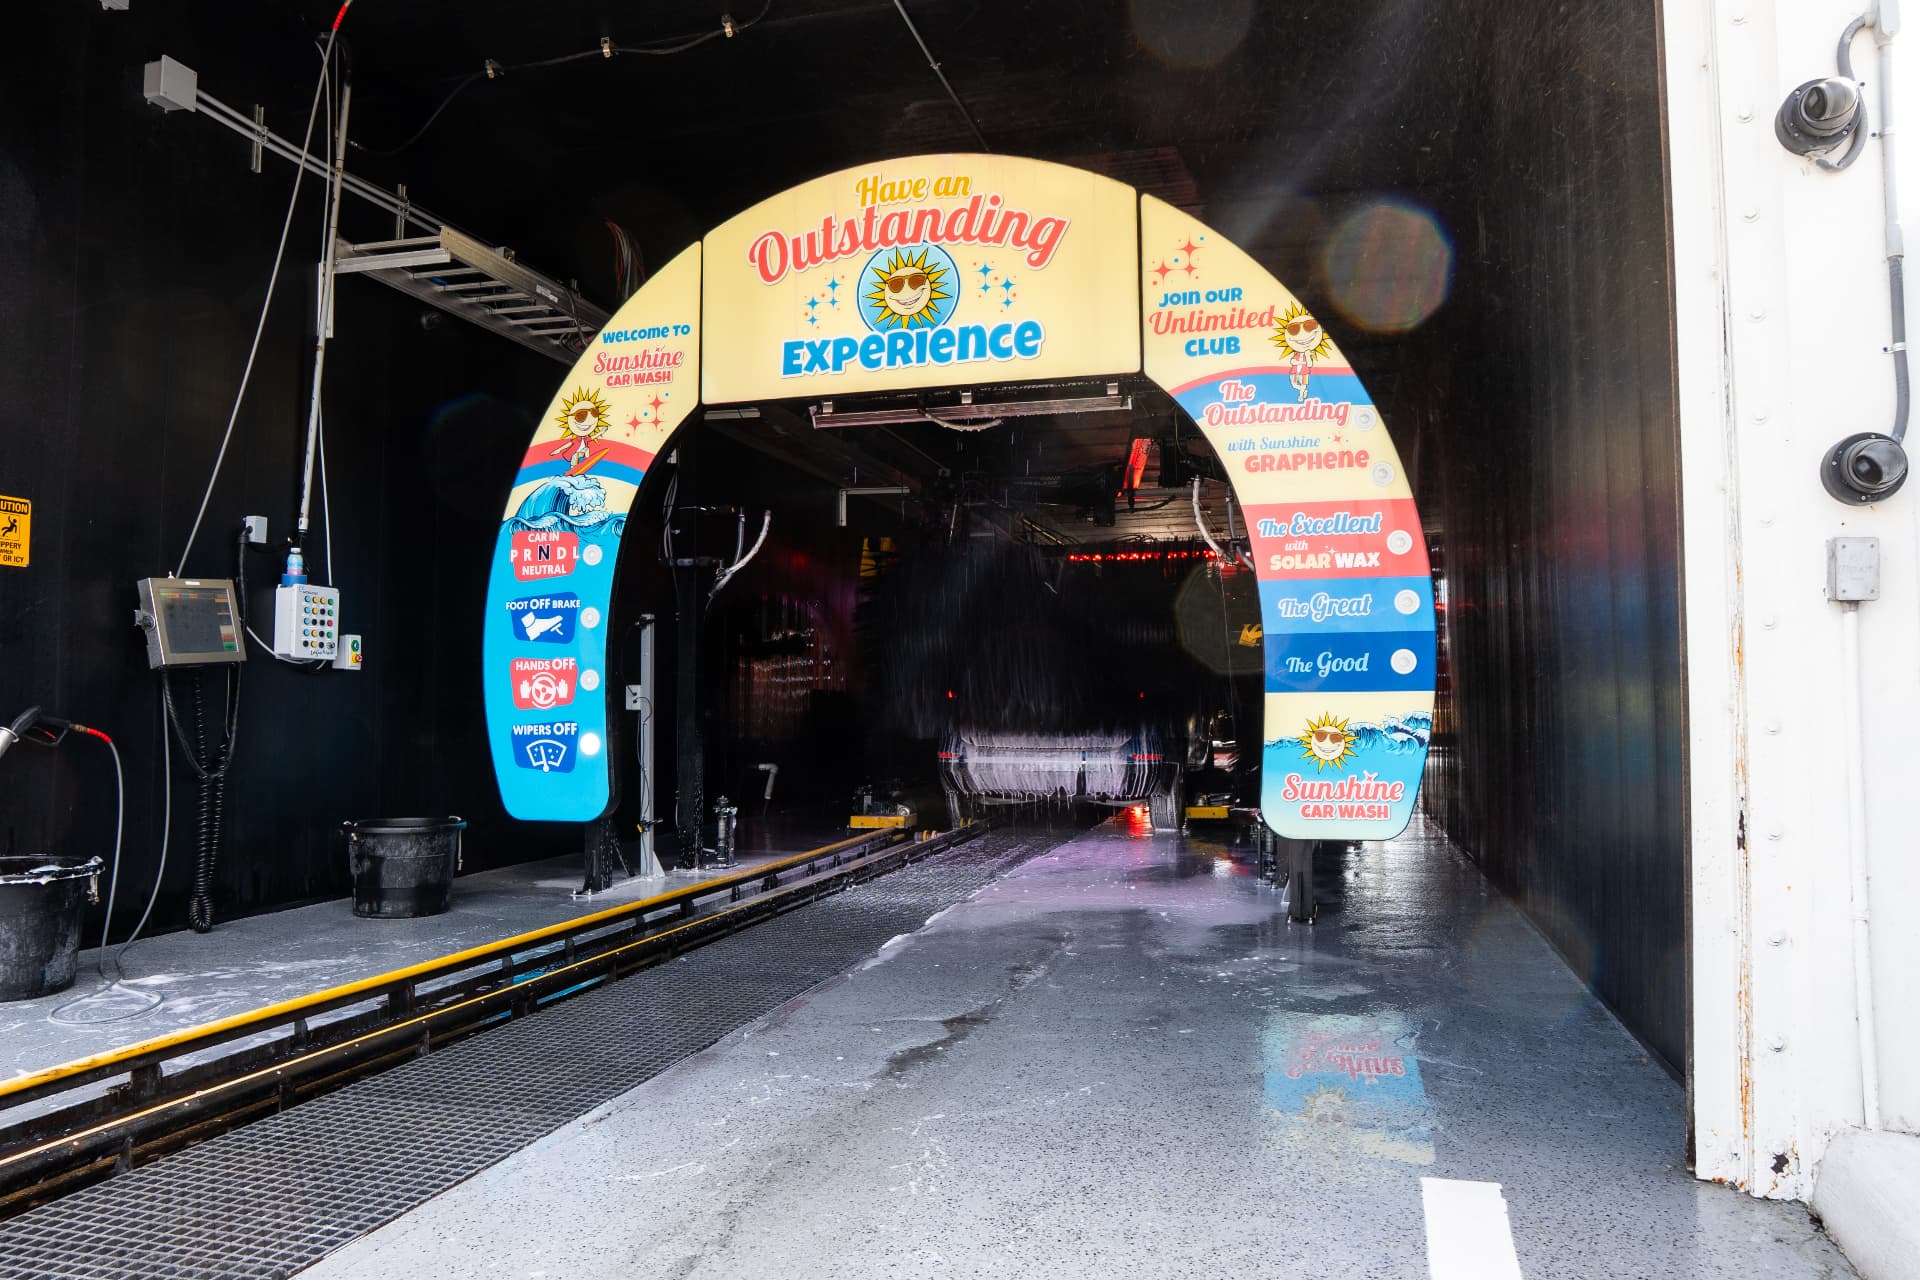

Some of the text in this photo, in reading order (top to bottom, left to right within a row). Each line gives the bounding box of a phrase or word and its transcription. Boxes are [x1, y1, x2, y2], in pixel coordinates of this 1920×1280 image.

[856, 174, 971, 208] Have an
[748, 194, 1070, 285] Outstanding
[1205, 287, 1243, 304] OUR
[1148, 305, 1275, 335] Unlimited
[672, 324, 691, 337] TO
[1184, 336, 1240, 357] CLUB
[593, 346, 684, 375] Sunshine
[606, 370, 672, 387] CAR WASH
[1219, 380, 1255, 402] The
[1204, 397, 1352, 427] Outstanding
[1227, 434, 1320, 453] with Sunshine
[1257, 512, 1383, 538] The Excellent
[528, 532, 560, 543] CAR IN
[1285, 540, 1309, 551] with
[510, 544, 580, 562] P R N D L
[1270, 552, 1380, 571] SOLAR WAX
[522, 564, 567, 576] NEUTRAL
[505, 598, 581, 611] FOOT OFF BRAKE
[1278, 592, 1373, 623] The Great
[515, 658, 576, 671] HANDS OFF
[1286, 651, 1370, 677] The Good
[512, 722, 578, 736] WIPERS OFF
[1282, 772, 1405, 802] Sunshine
[1301, 804, 1391, 820] CAR WASH
